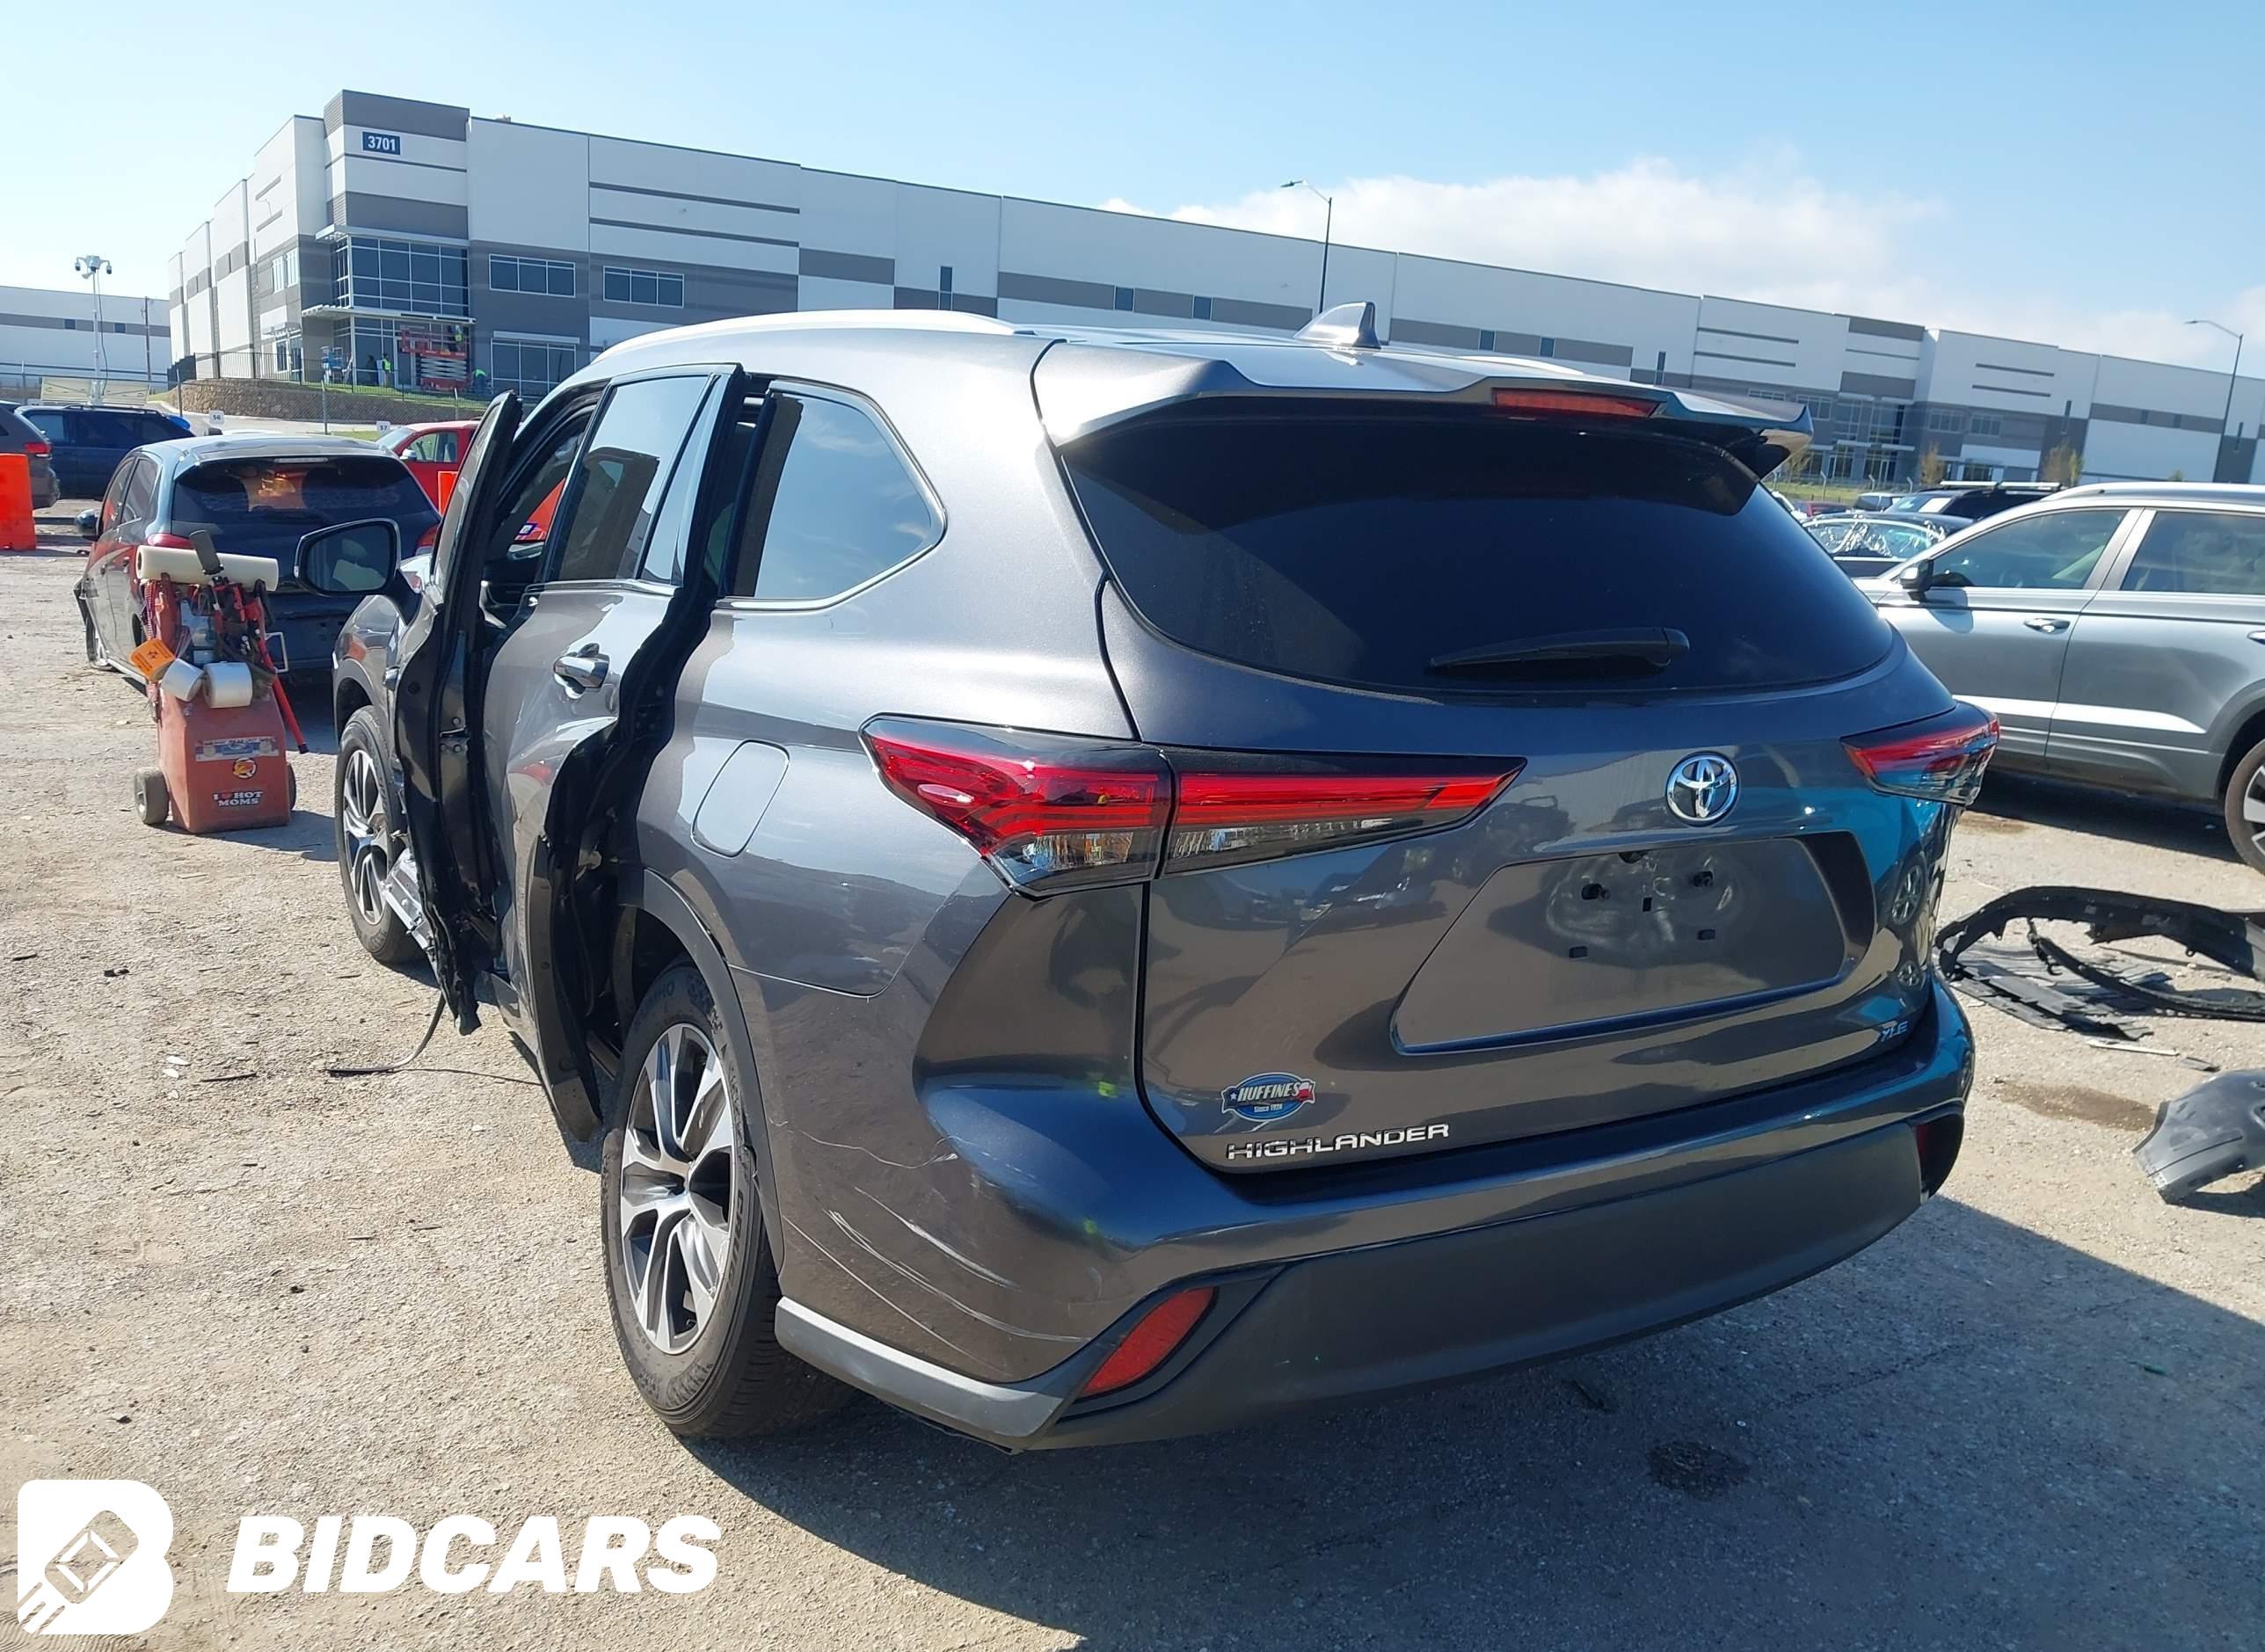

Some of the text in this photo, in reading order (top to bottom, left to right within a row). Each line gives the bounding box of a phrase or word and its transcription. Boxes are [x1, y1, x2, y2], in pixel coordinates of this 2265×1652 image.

[368, 135, 396, 152] 3701
[218, 797, 259, 807] MOMS
[1237, 1082, 1300, 1103] HUFFINES
[1227, 1124, 1450, 1161] HIGHLANDER
